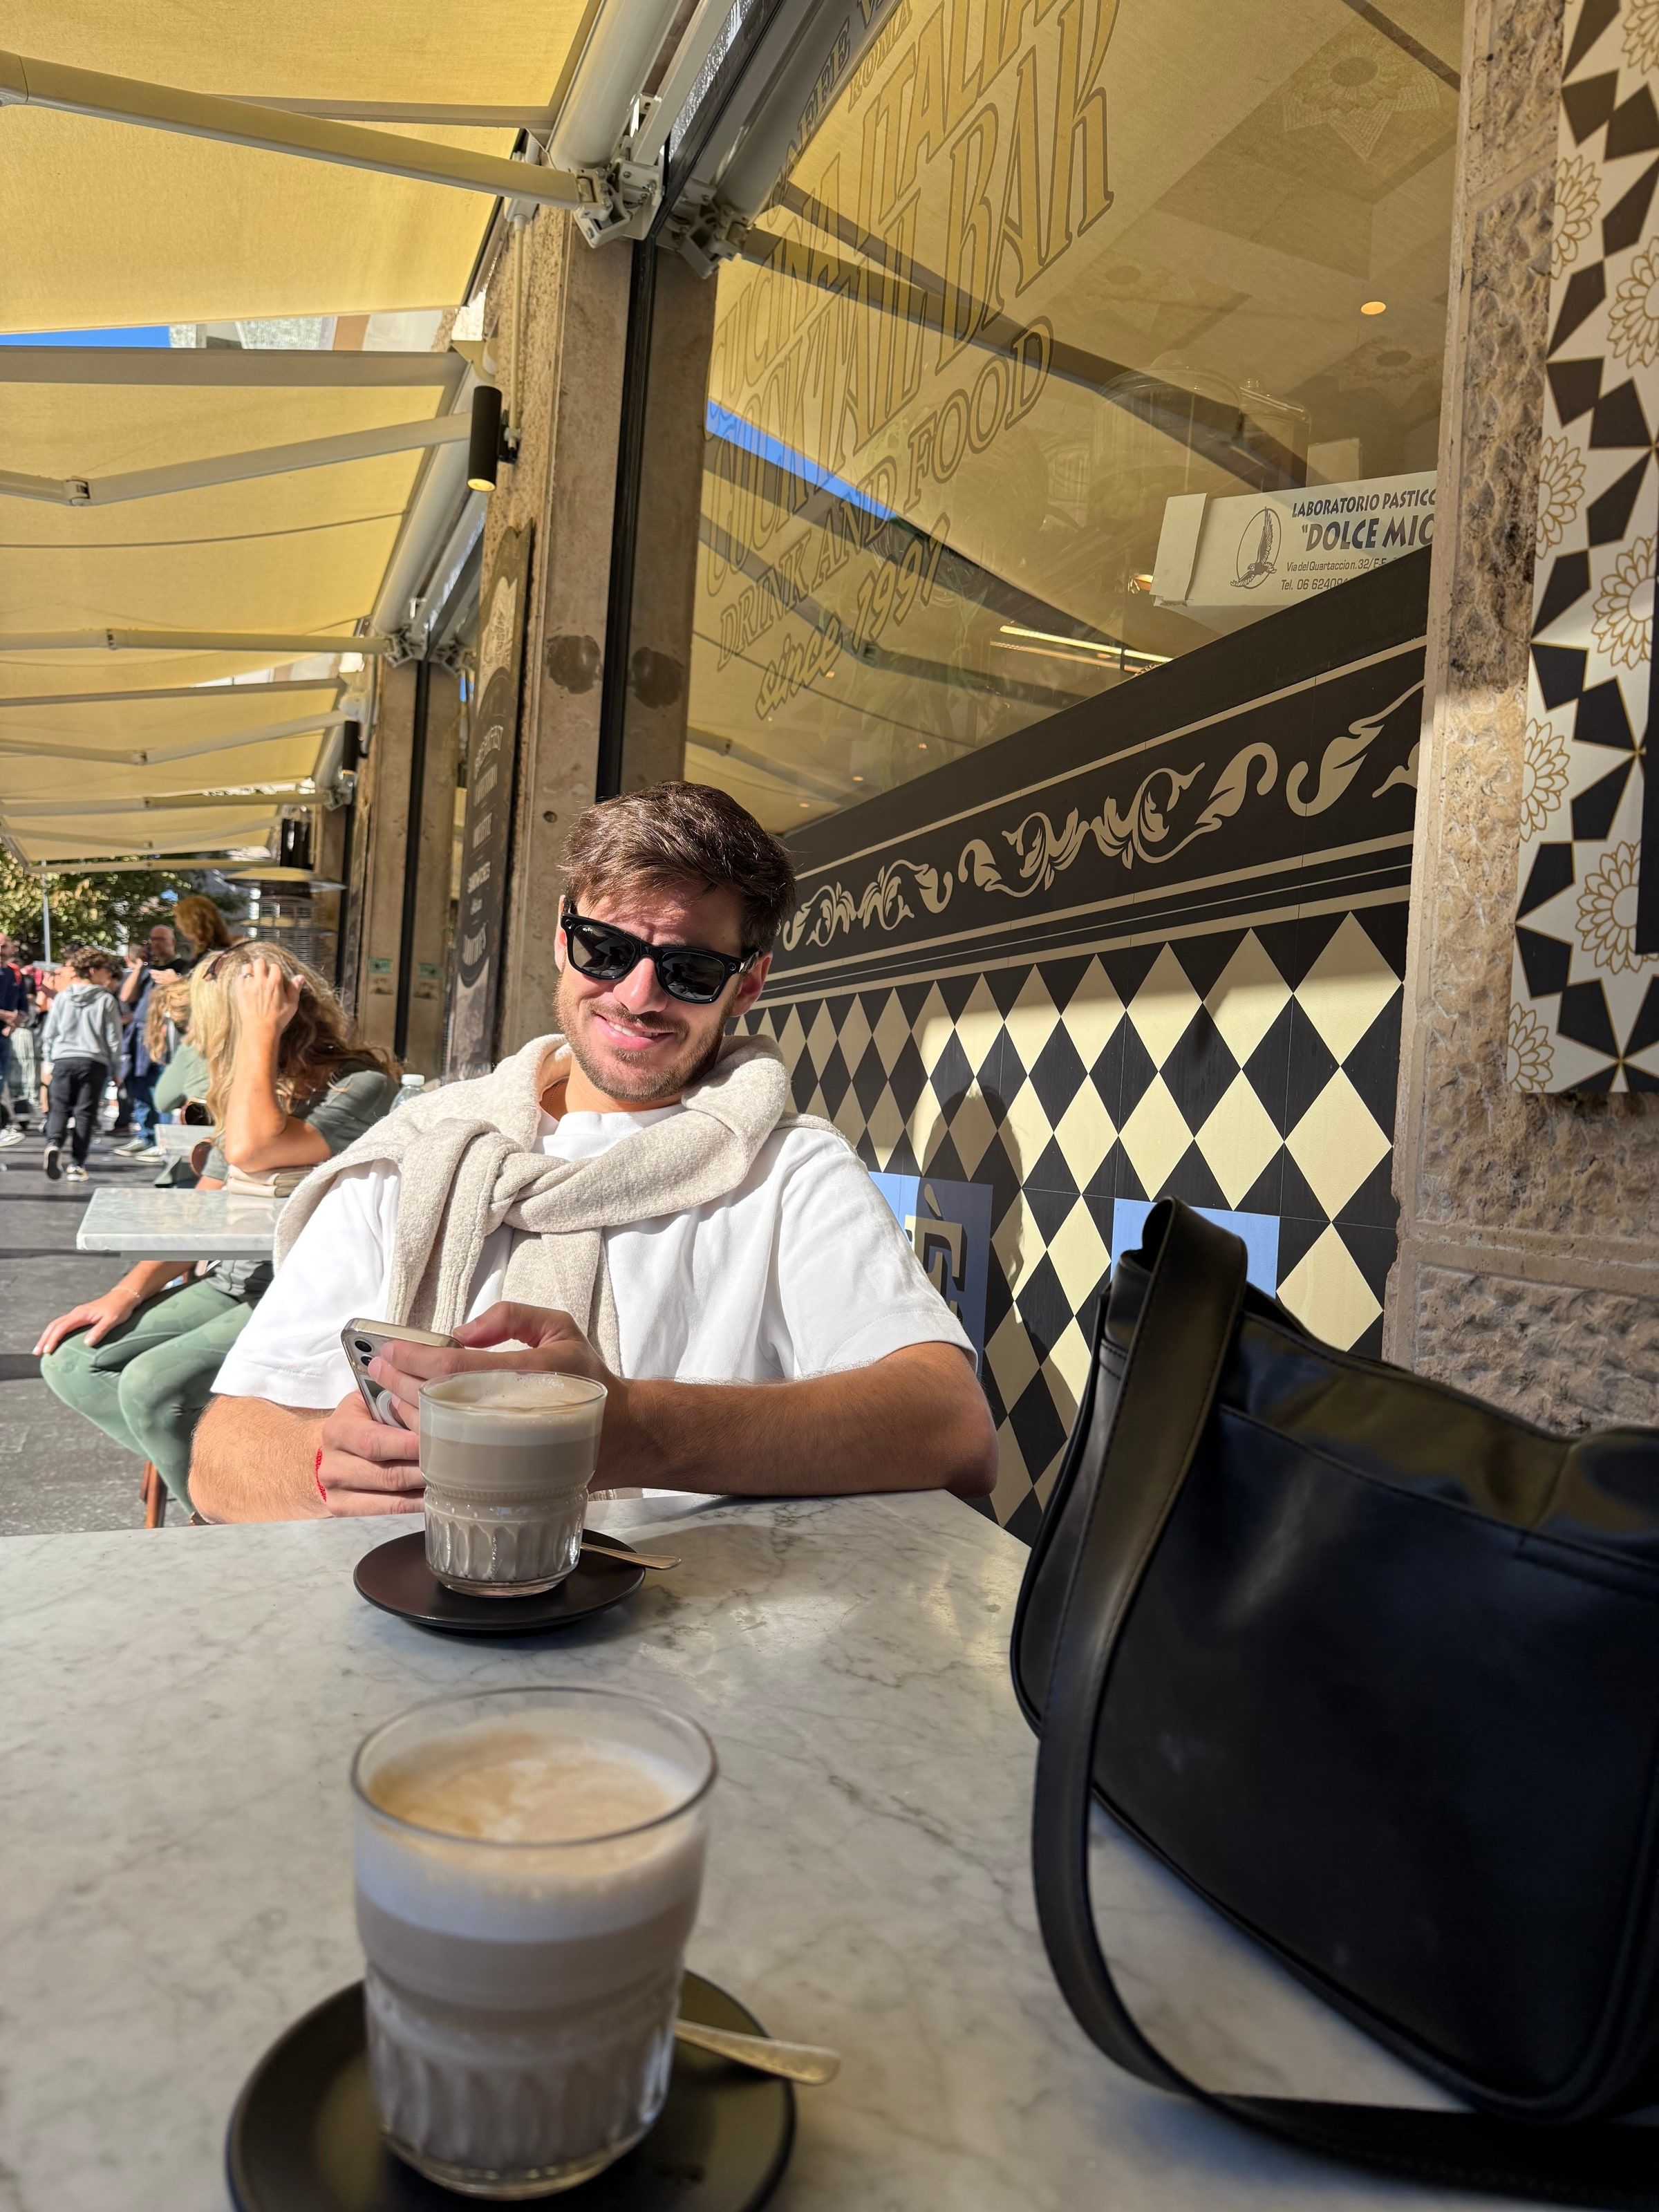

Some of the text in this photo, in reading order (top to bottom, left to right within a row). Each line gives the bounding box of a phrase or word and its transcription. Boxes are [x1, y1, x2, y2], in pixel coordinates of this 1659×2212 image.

[706, 0, 1120, 596] COCKTAIL BAR
[717, 316, 1053, 672] DRINK AND FOOD
[1292, 488, 1436, 518] LABORATORIO PASTICC
[1282, 579, 1293, 590] Tel.
[1297, 579, 1309, 590] 06
[1287, 562, 1297, 572] Via
[1298, 561, 1309, 572] del
[1309, 560, 1349, 571] Quartaccio
[756, 611, 843, 720] since
